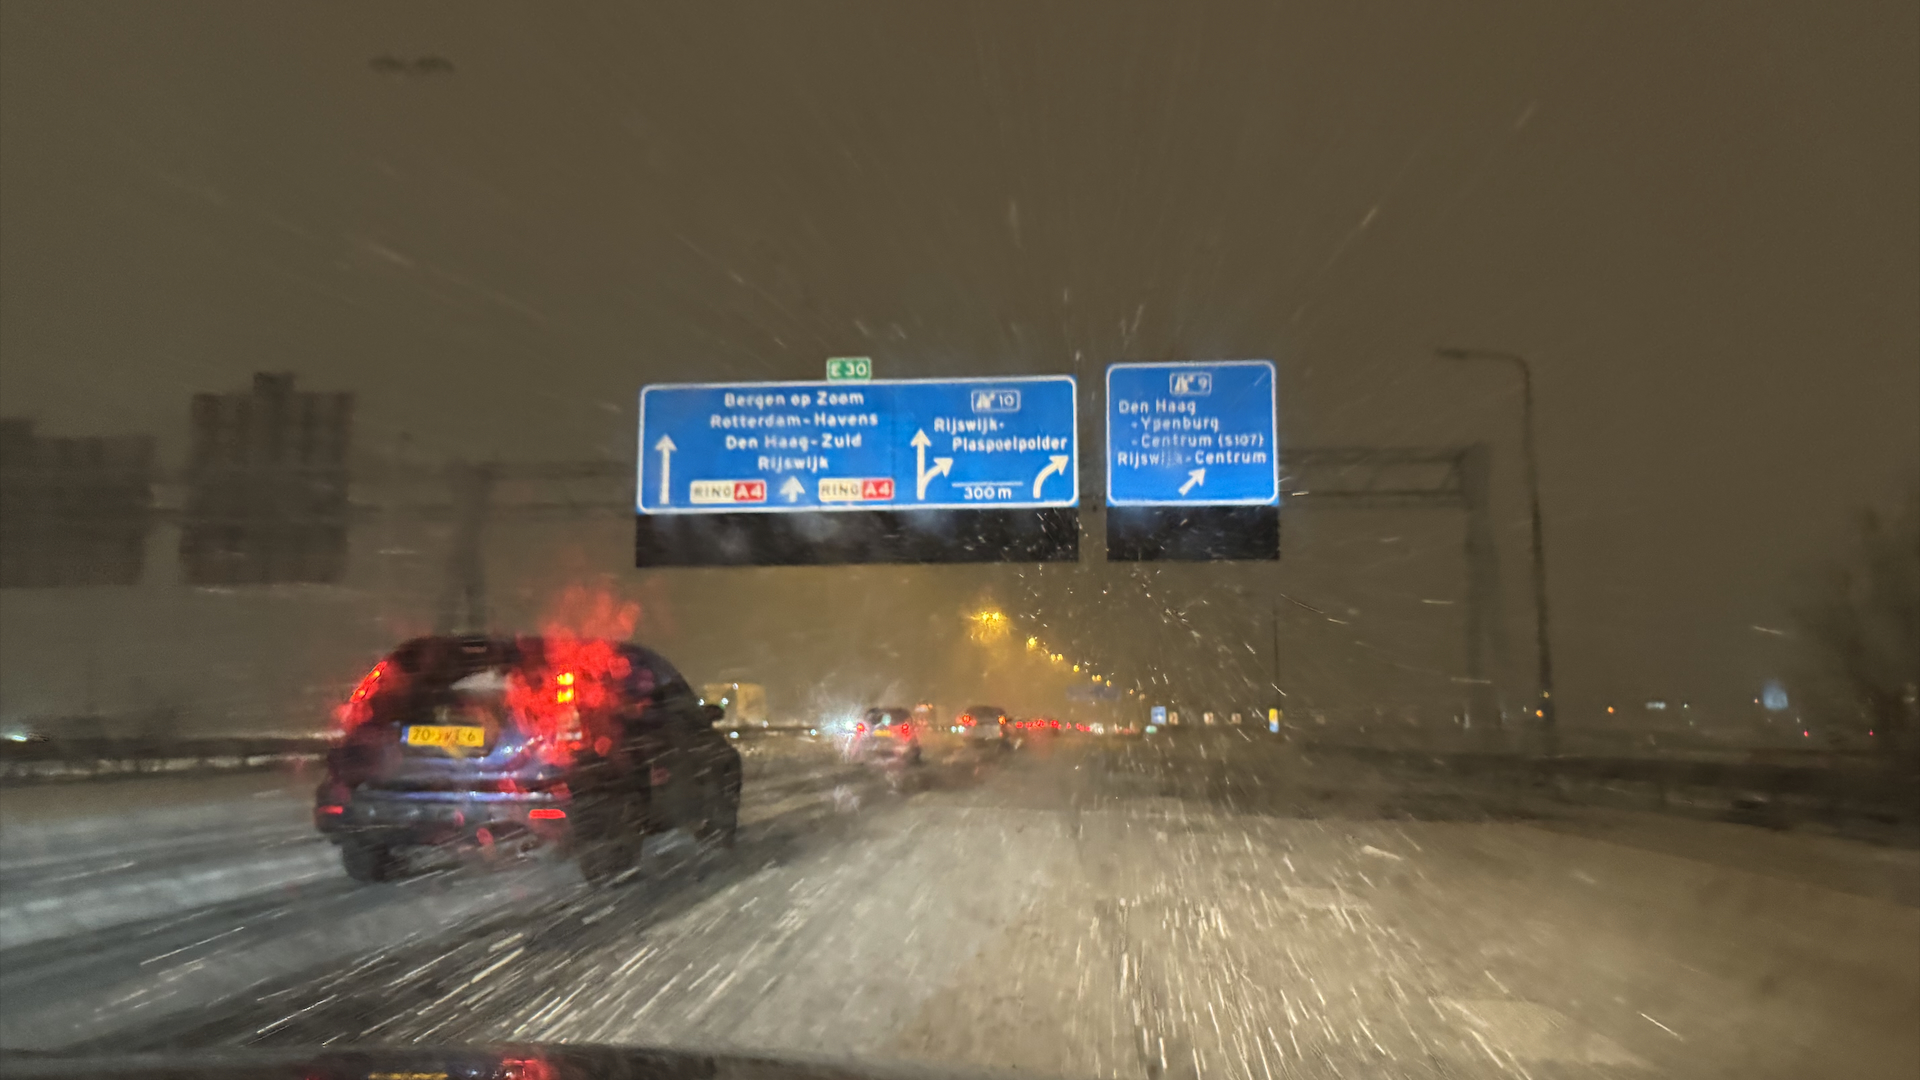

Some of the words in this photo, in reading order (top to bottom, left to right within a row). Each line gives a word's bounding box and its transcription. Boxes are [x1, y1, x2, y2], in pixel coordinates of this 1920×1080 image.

[831, 364, 842, 376] E
[845, 363, 867, 376] 30
[1198, 377, 1208, 390] 9
[724, 393, 786, 409] Bergen
[791, 394, 811, 408] op
[817, 391, 864, 406] Zoom
[999, 394, 1015, 407] 10
[1119, 400, 1149, 414] Den
[1156, 399, 1196, 416] Haag
[934, 417, 1005, 435] Rijswijk-
[726, 435, 758, 449] Den
[952, 435, 1067, 453] Plaspoelpolder
[758, 456, 828, 473] Rijswijk
[693, 485, 731, 498] RING
[735, 485, 763, 498] A4
[821, 485, 859, 498] RING
[864, 482, 891, 496] A4
[964, 487, 995, 500] 300
[998, 487, 1012, 499] m
